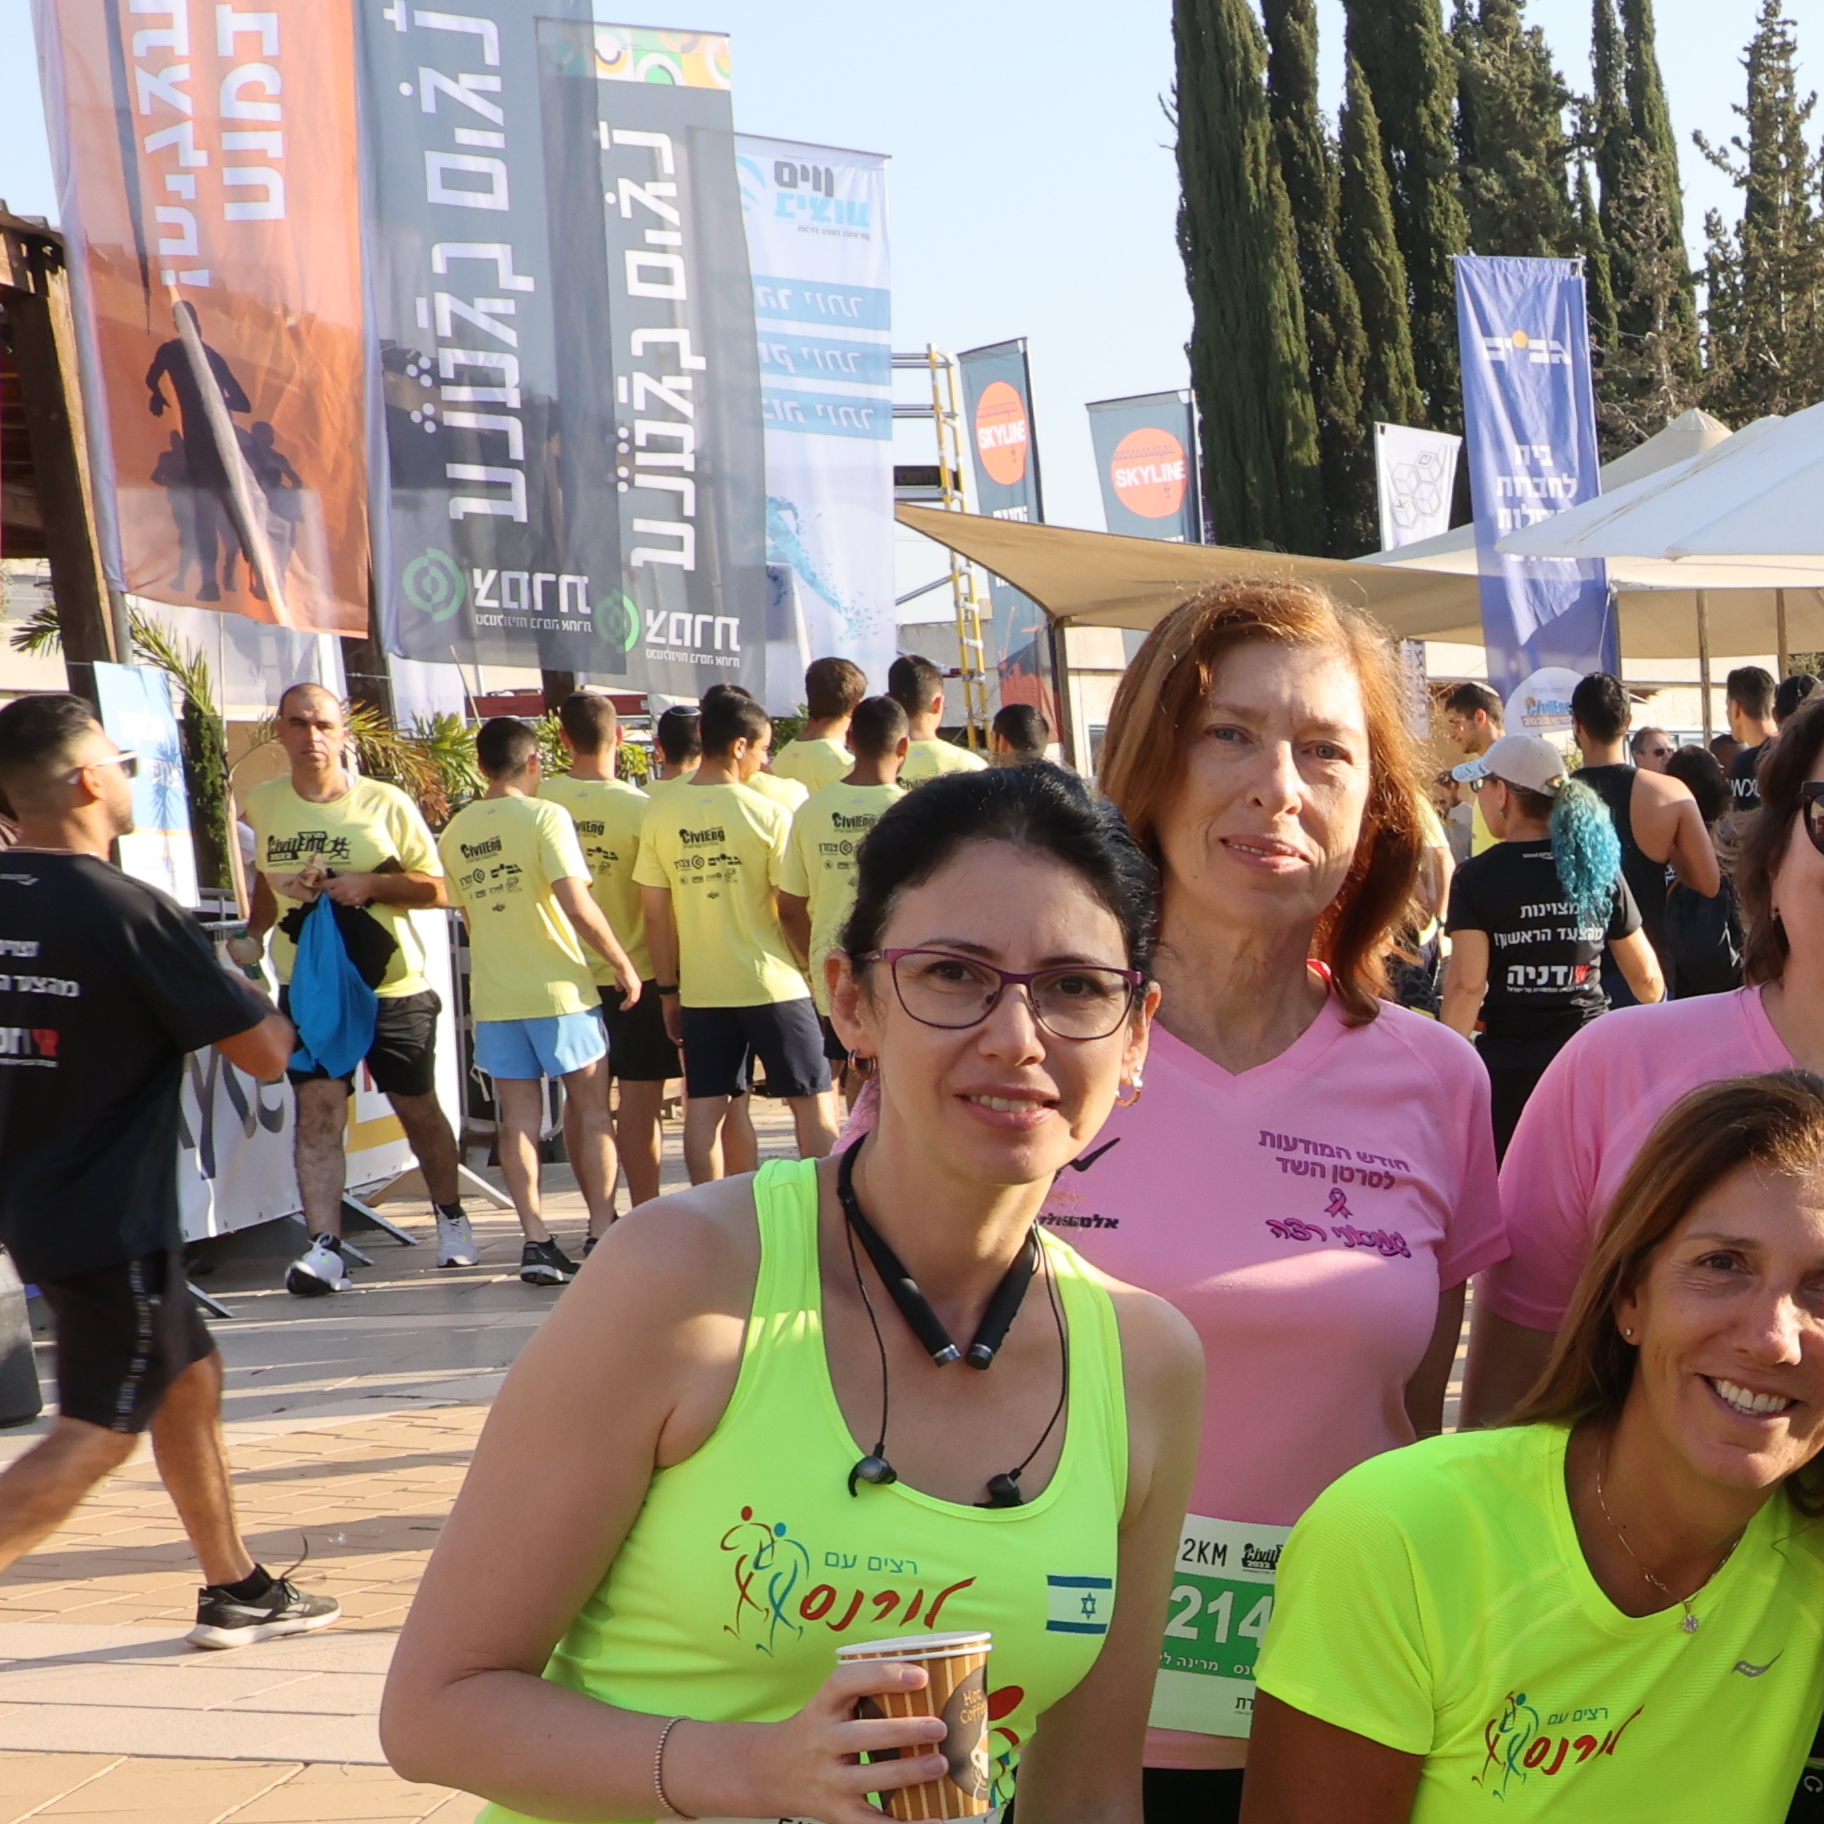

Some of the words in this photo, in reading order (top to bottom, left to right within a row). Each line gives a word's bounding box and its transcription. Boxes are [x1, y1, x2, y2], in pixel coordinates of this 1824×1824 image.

[977, 420, 1027, 453] SKYLINE
[1515, 444, 1554, 467] בית
[1114, 457, 1187, 491] SKYLINE
[1496, 472, 1578, 499] לחברות
[678, 828, 726, 844] CivilEng
[459, 837, 502, 861] CivilEng
[1520, 901, 1581, 919] מצוינות
[1494, 928, 1552, 949] הראשון!
[1507, 965, 1568, 986] דניה
[1258, 1127, 1351, 1162] המודעות
[1276, 1154, 1327, 1180] השד
[1356, 1149, 1410, 1174] חודש
[1332, 1163, 1396, 1191] לסרטן
[824, 1551, 857, 1570] עם
[867, 1555, 919, 1575] רצים
[799, 1575, 977, 1632] לורנס
[1163, 1584, 1275, 1645] 214
[1176, 1654, 1219, 1671] מרינה
[1547, 1709, 1570, 1726] עם
[1571, 1705, 1609, 1723] רצים
